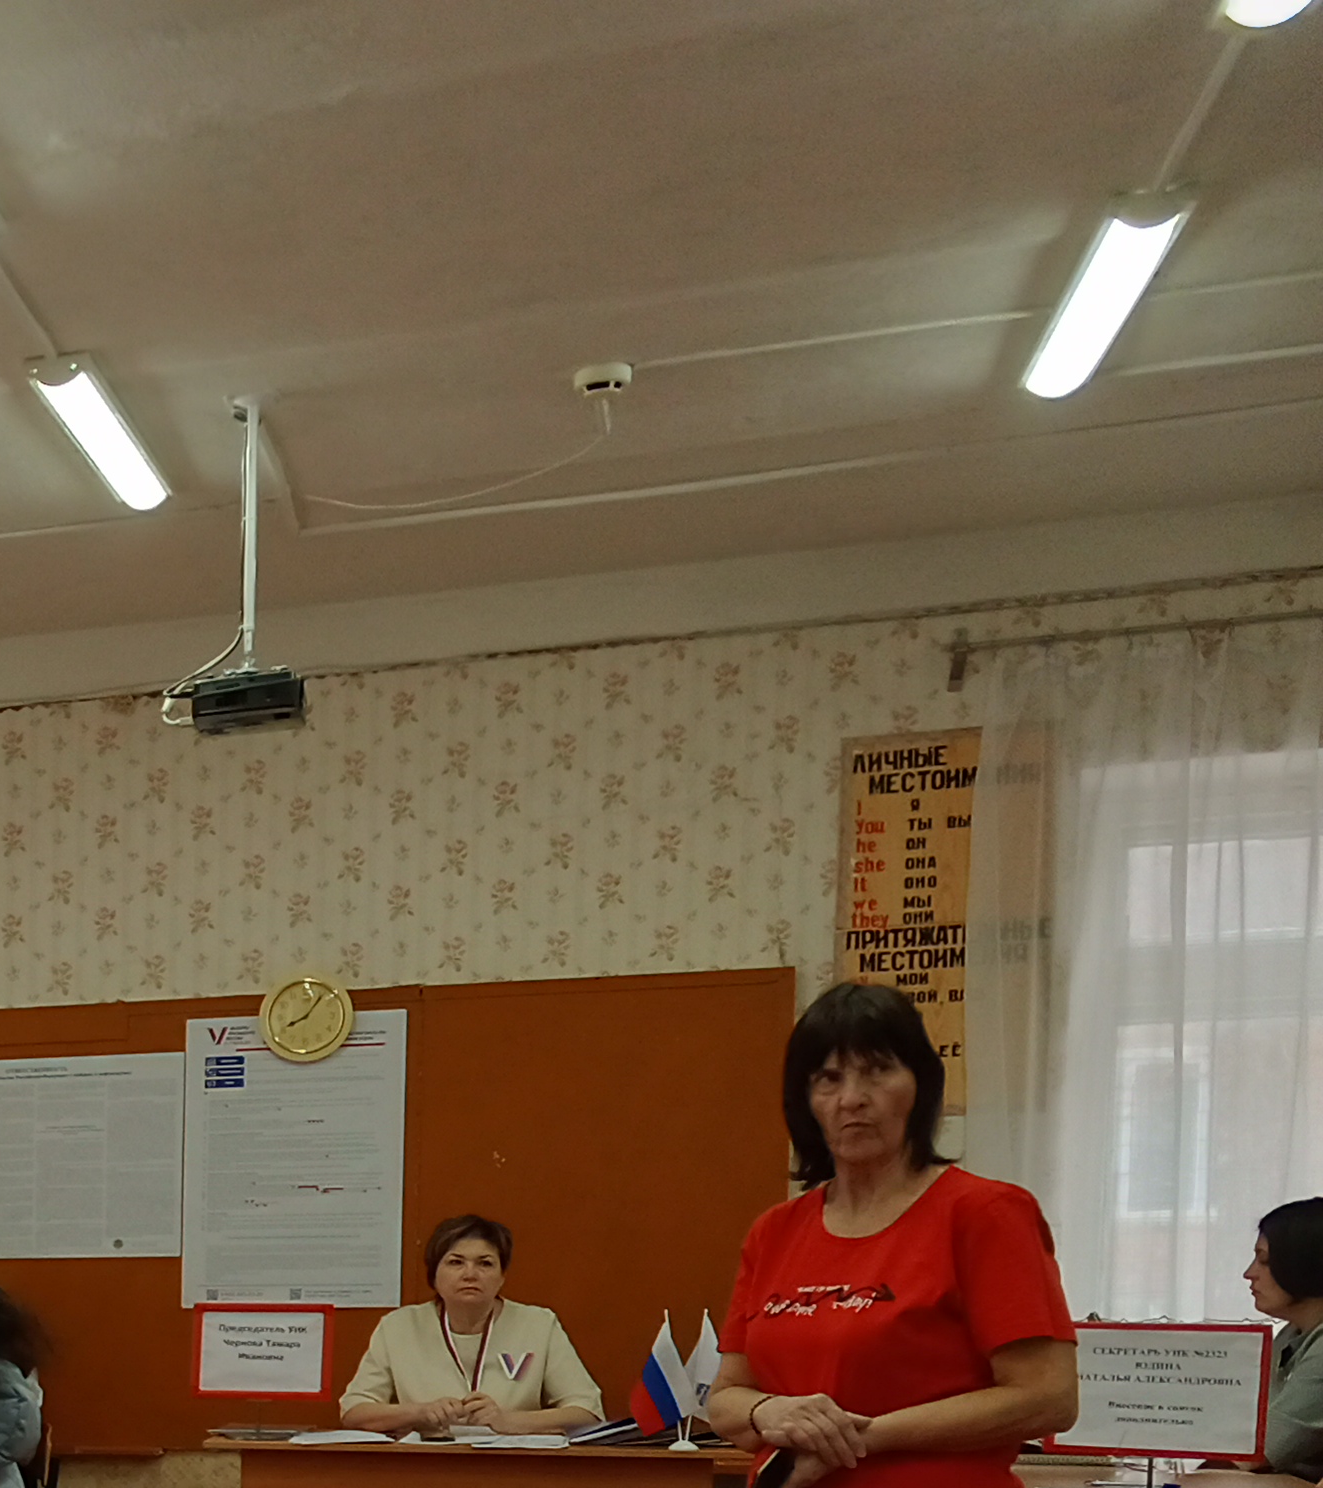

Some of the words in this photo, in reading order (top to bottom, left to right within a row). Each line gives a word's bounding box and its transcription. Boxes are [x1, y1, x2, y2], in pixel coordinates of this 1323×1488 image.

[853, 745, 948, 775] ЛИЧНЫЕ
[910, 799, 920, 812] Я
[907, 818, 932, 831] ТЫ
[856, 838, 877, 853] he
[906, 837, 926, 850] ОН
[853, 857, 886, 874] she
[905, 856, 937, 870] ОНА
[904, 875, 938, 890] ОНО
[853, 899, 878, 912] we
[903, 895, 932, 909] МЫ
[851, 912, 889, 929] they
[902, 910, 934, 925] ОНИ
[1092, 1346, 1161, 1356] СЕКРЕТАРЬ
